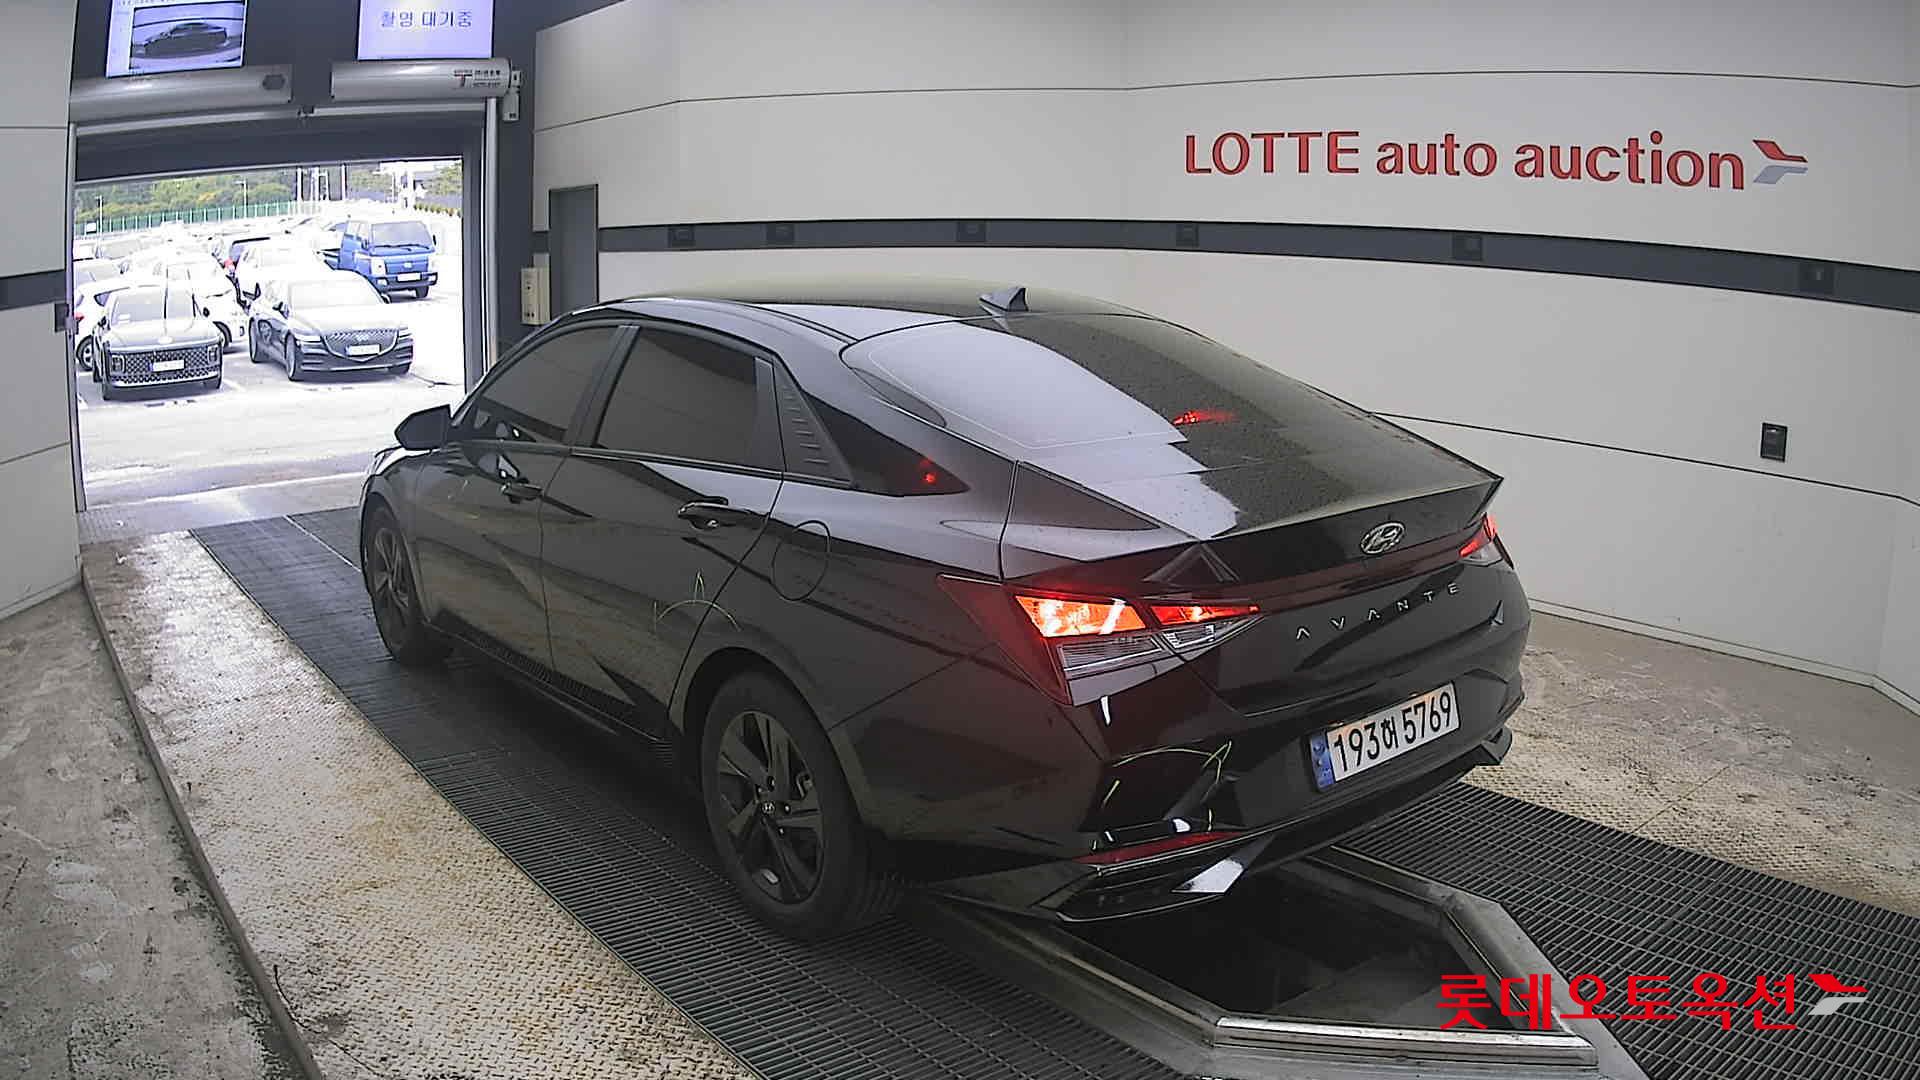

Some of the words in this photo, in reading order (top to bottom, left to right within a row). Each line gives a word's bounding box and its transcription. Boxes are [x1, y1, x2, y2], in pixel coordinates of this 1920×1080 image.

[421, 11, 473, 27] 대기중
[1185, 131, 1360, 175] LOTTE
[1376, 132, 1498, 177] auto
[1514, 130, 1745, 190] auction
[1296, 582, 1460, 641] AVANTE
